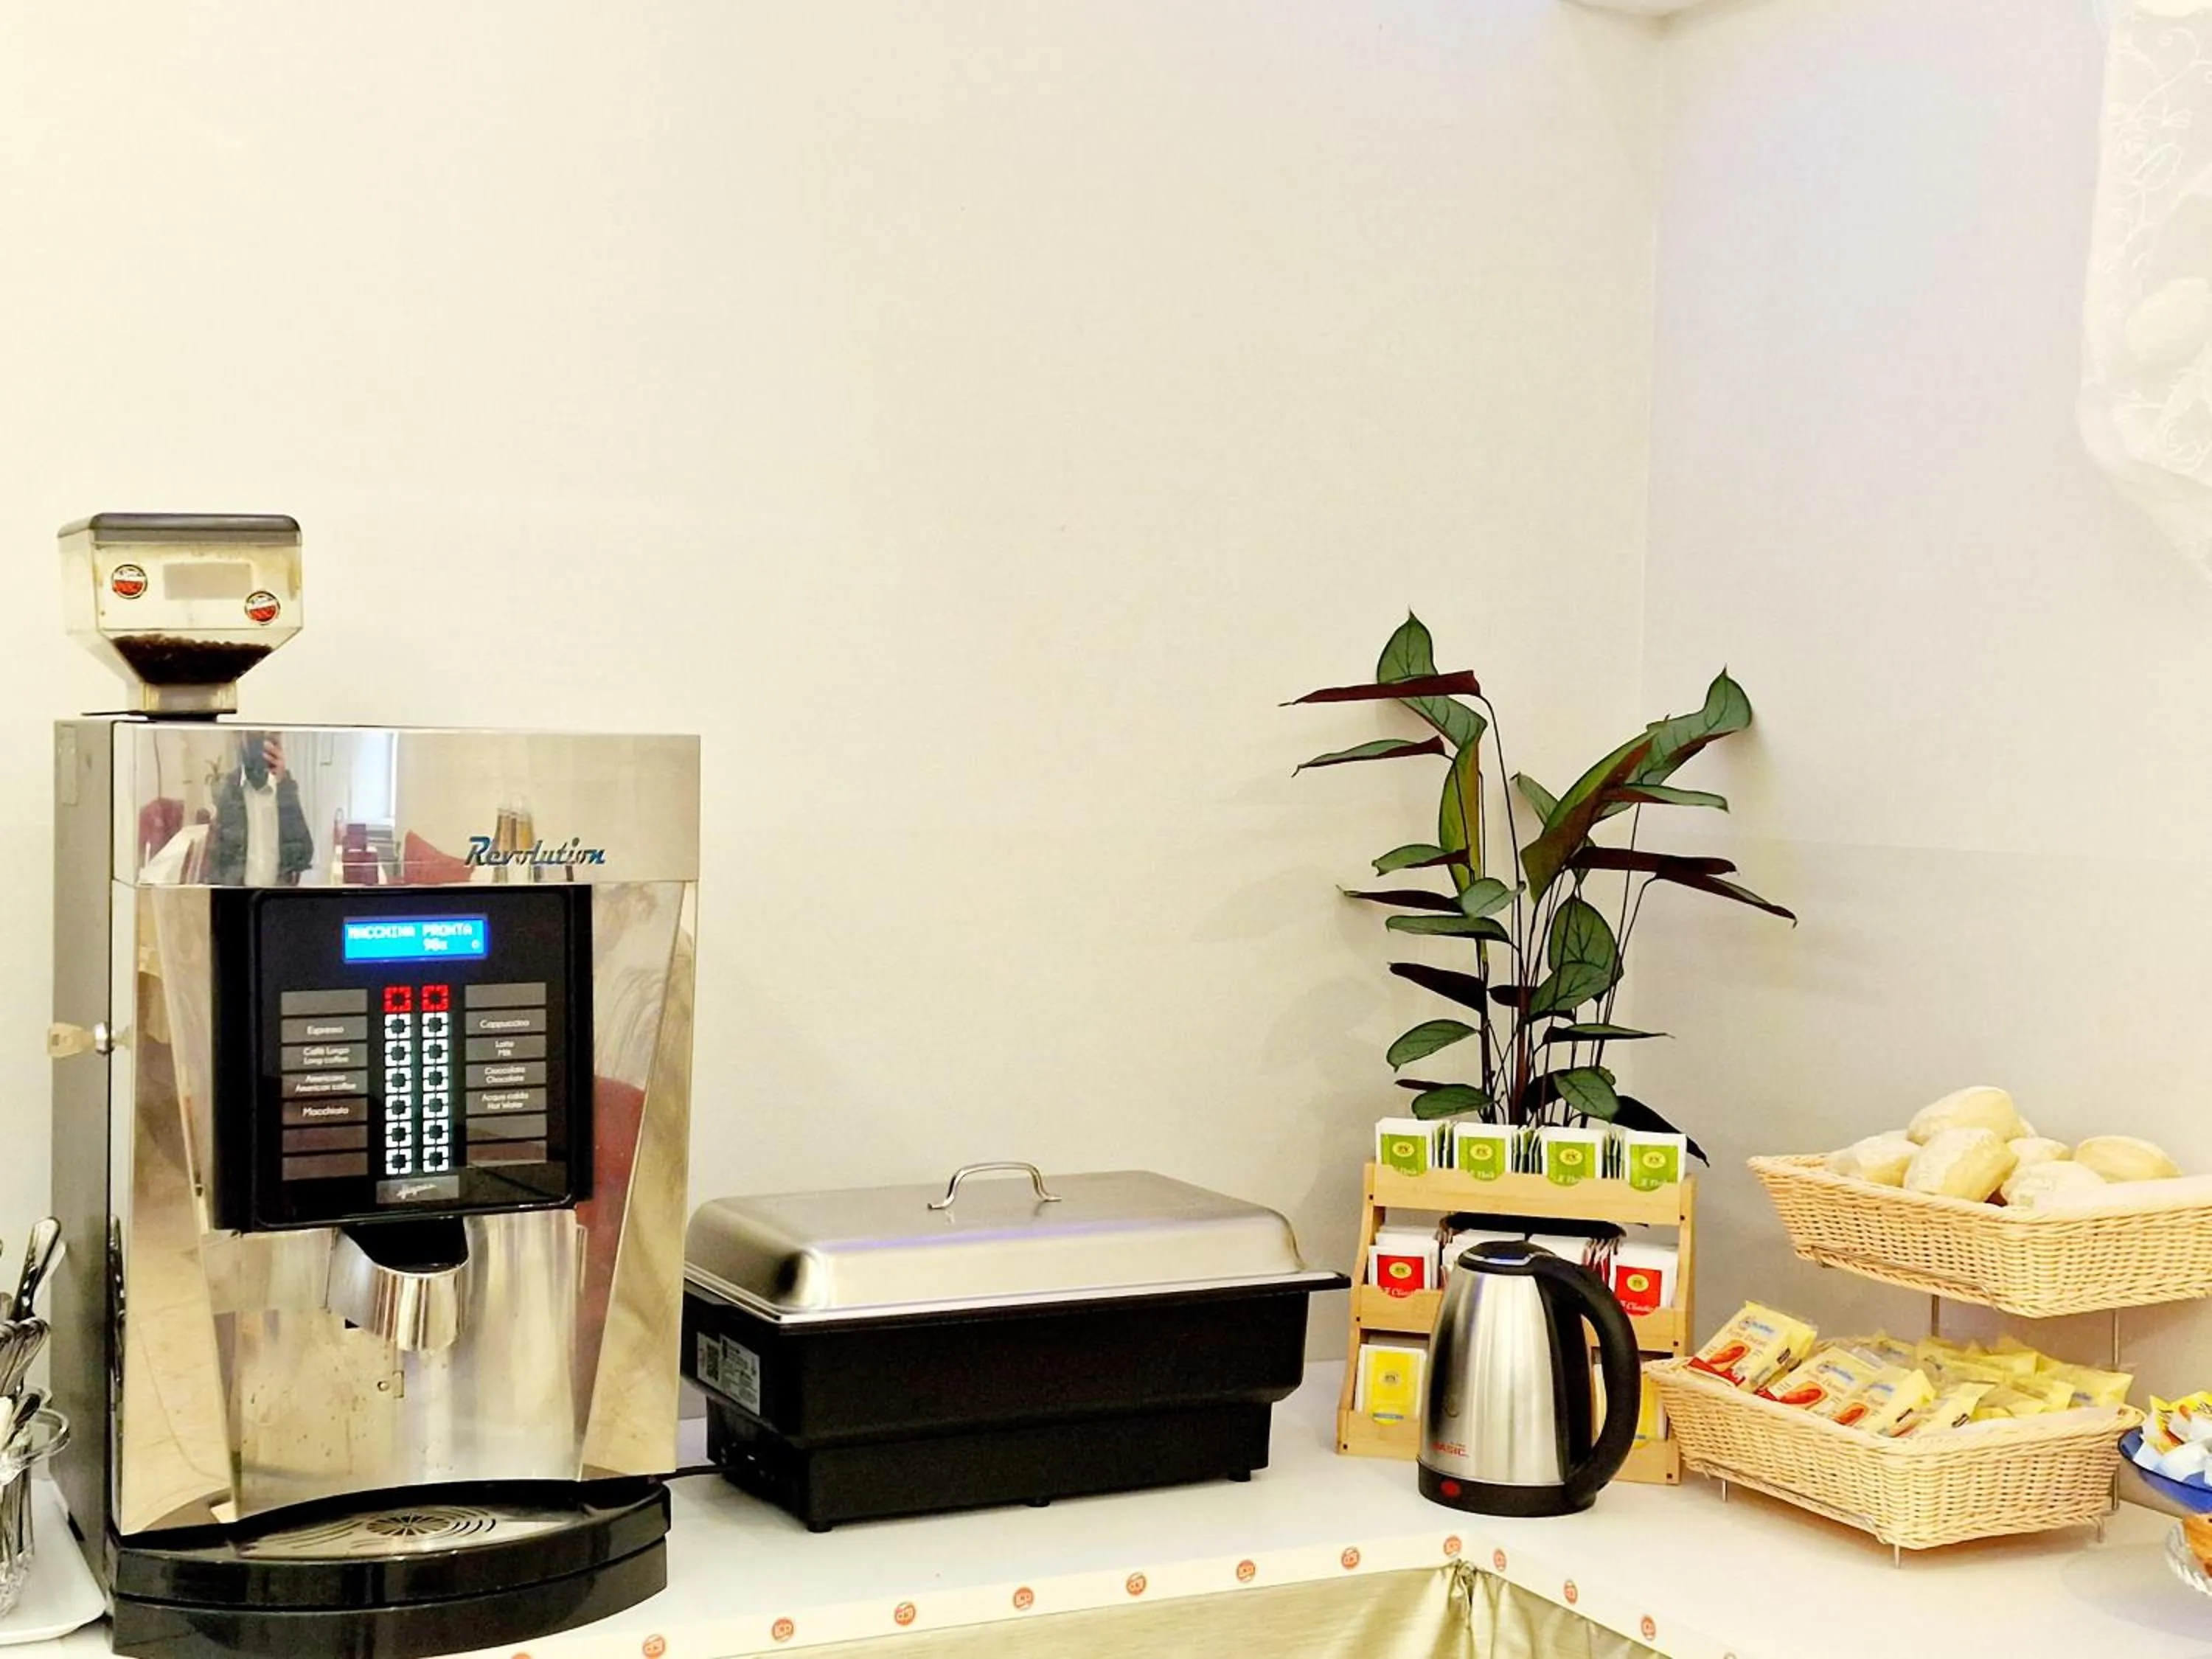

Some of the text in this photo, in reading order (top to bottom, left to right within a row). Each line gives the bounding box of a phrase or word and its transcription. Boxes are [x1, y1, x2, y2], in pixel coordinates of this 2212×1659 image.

[465, 835, 605, 866] Revolution
[422, 923, 473, 937] PRONTA
[479, 1019, 530, 1029] Cappuccino
[307, 1026, 344, 1036] Espresso
[303, 1056, 349, 1065] Long coffee
[302, 1107, 349, 1117] Macchiato
